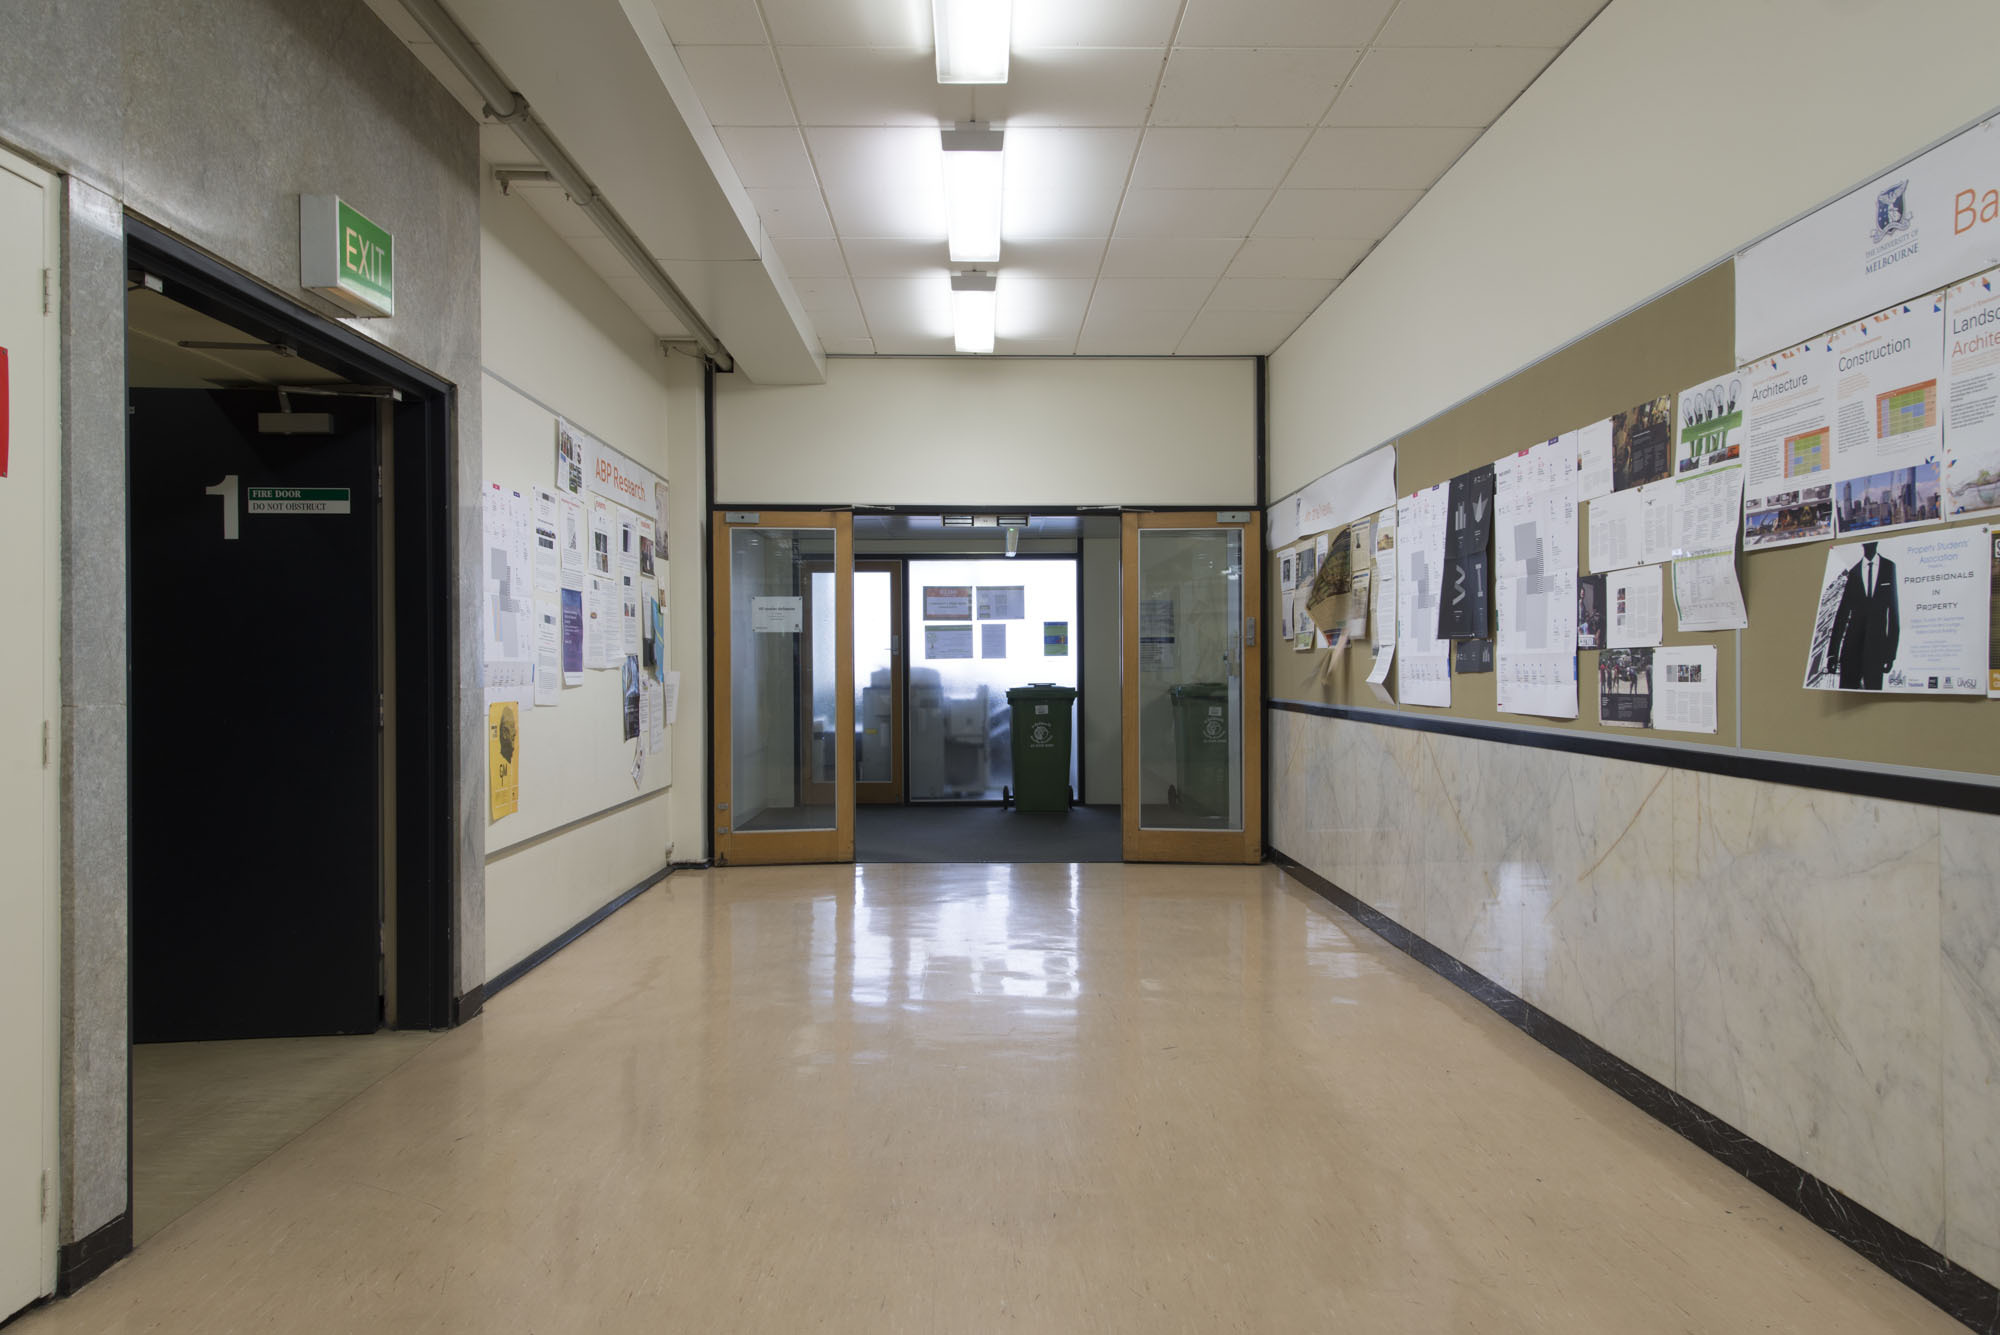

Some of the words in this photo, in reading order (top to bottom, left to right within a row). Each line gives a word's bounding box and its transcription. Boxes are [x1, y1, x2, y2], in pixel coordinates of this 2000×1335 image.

[1954, 188, 1999, 236] Ba
[1876, 233, 1910, 253] UNIVERSITY
[346, 226, 385, 287] EXIT
[1865, 242, 1919, 275] MELBOURNE
[1838, 336, 1911, 372] Construction
[1751, 373, 1808, 402] Architecture
[595, 456, 612, 484] ABP
[613, 466, 646, 502] Research
[252, 490, 273, 498] FIRE
[275, 490, 302, 498] DOOR
[206, 475, 239, 540] 1
[253, 502, 265, 511] DO
[267, 502, 283, 511] NOT
[285, 502, 327, 511] OBSTRUCT
[1907, 544, 1936, 555] Property
[1919, 552, 1959, 564] Association
[1904, 571, 1975, 584] PROFESSIONALS
[1916, 602, 1959, 612] PROPERTY
